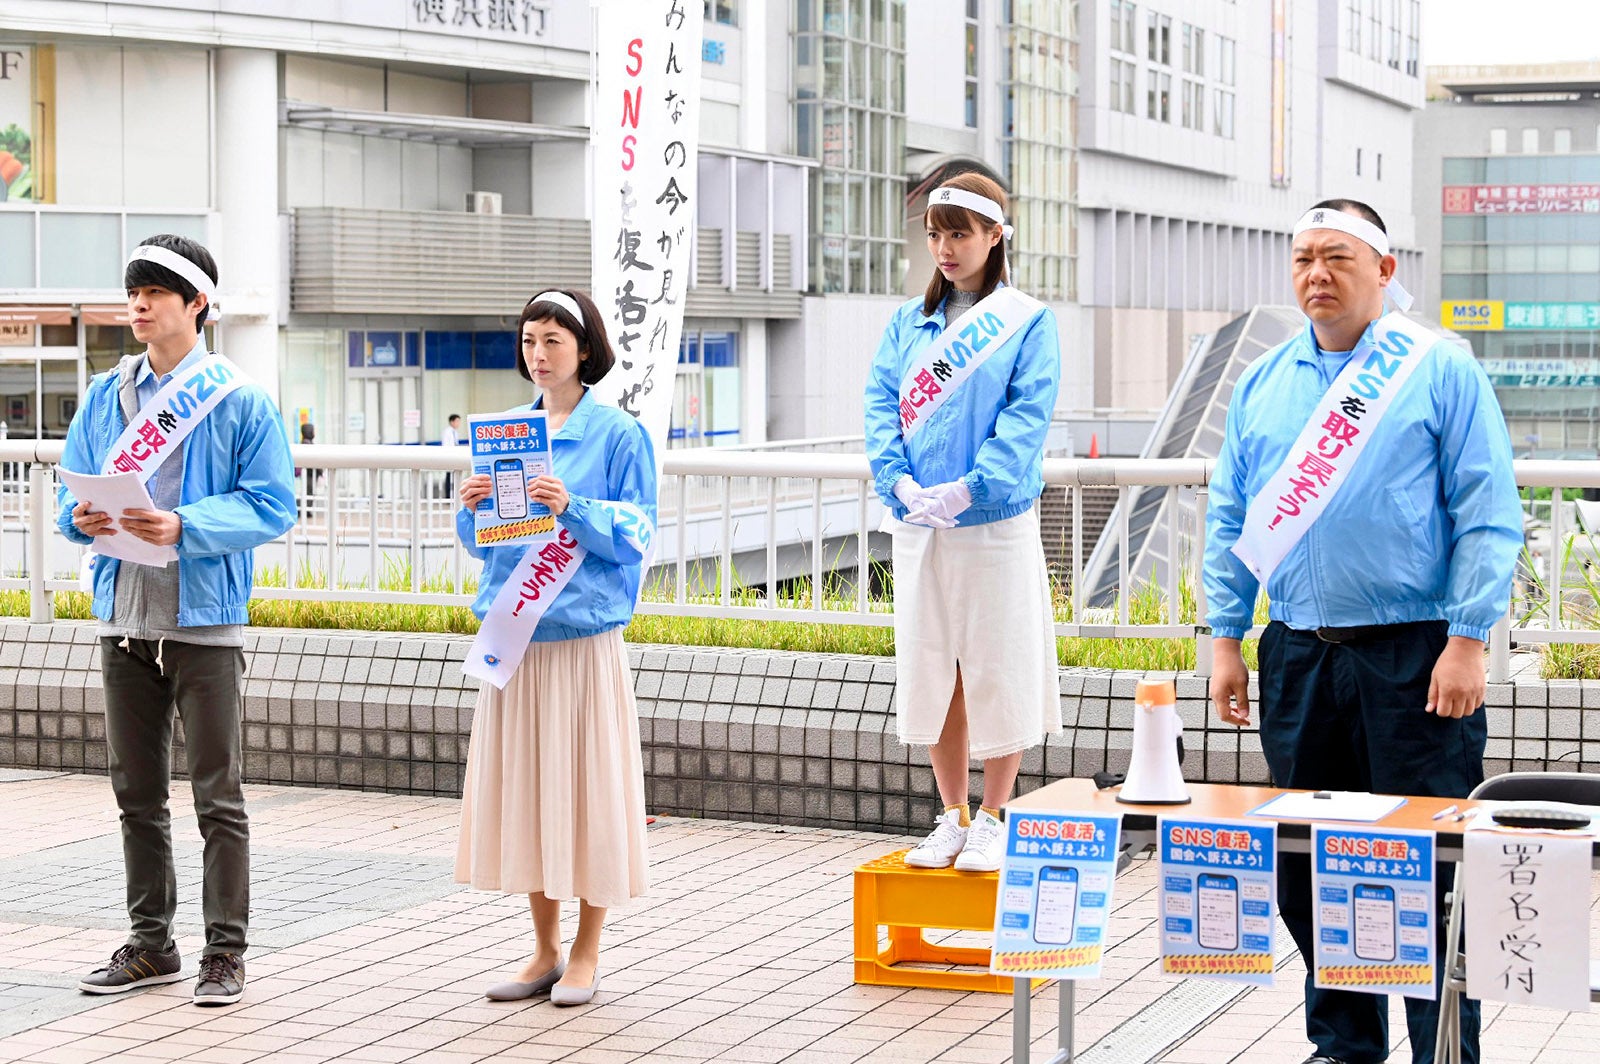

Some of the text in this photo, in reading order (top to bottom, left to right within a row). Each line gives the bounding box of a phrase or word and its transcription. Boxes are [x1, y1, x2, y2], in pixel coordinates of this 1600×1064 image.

[1453, 305, 1490, 317] MSG
[476, 422, 538, 440] SNS復活を
[1267, 330, 1415, 531] SNSを取り戻そう！
[1017, 819, 1106, 842] SNS復活を
[1170, 826, 1262, 852] SNS復活を
[1325, 836, 1420, 861] SNS復活を
[1496, 843, 1543, 994] 署名受付
